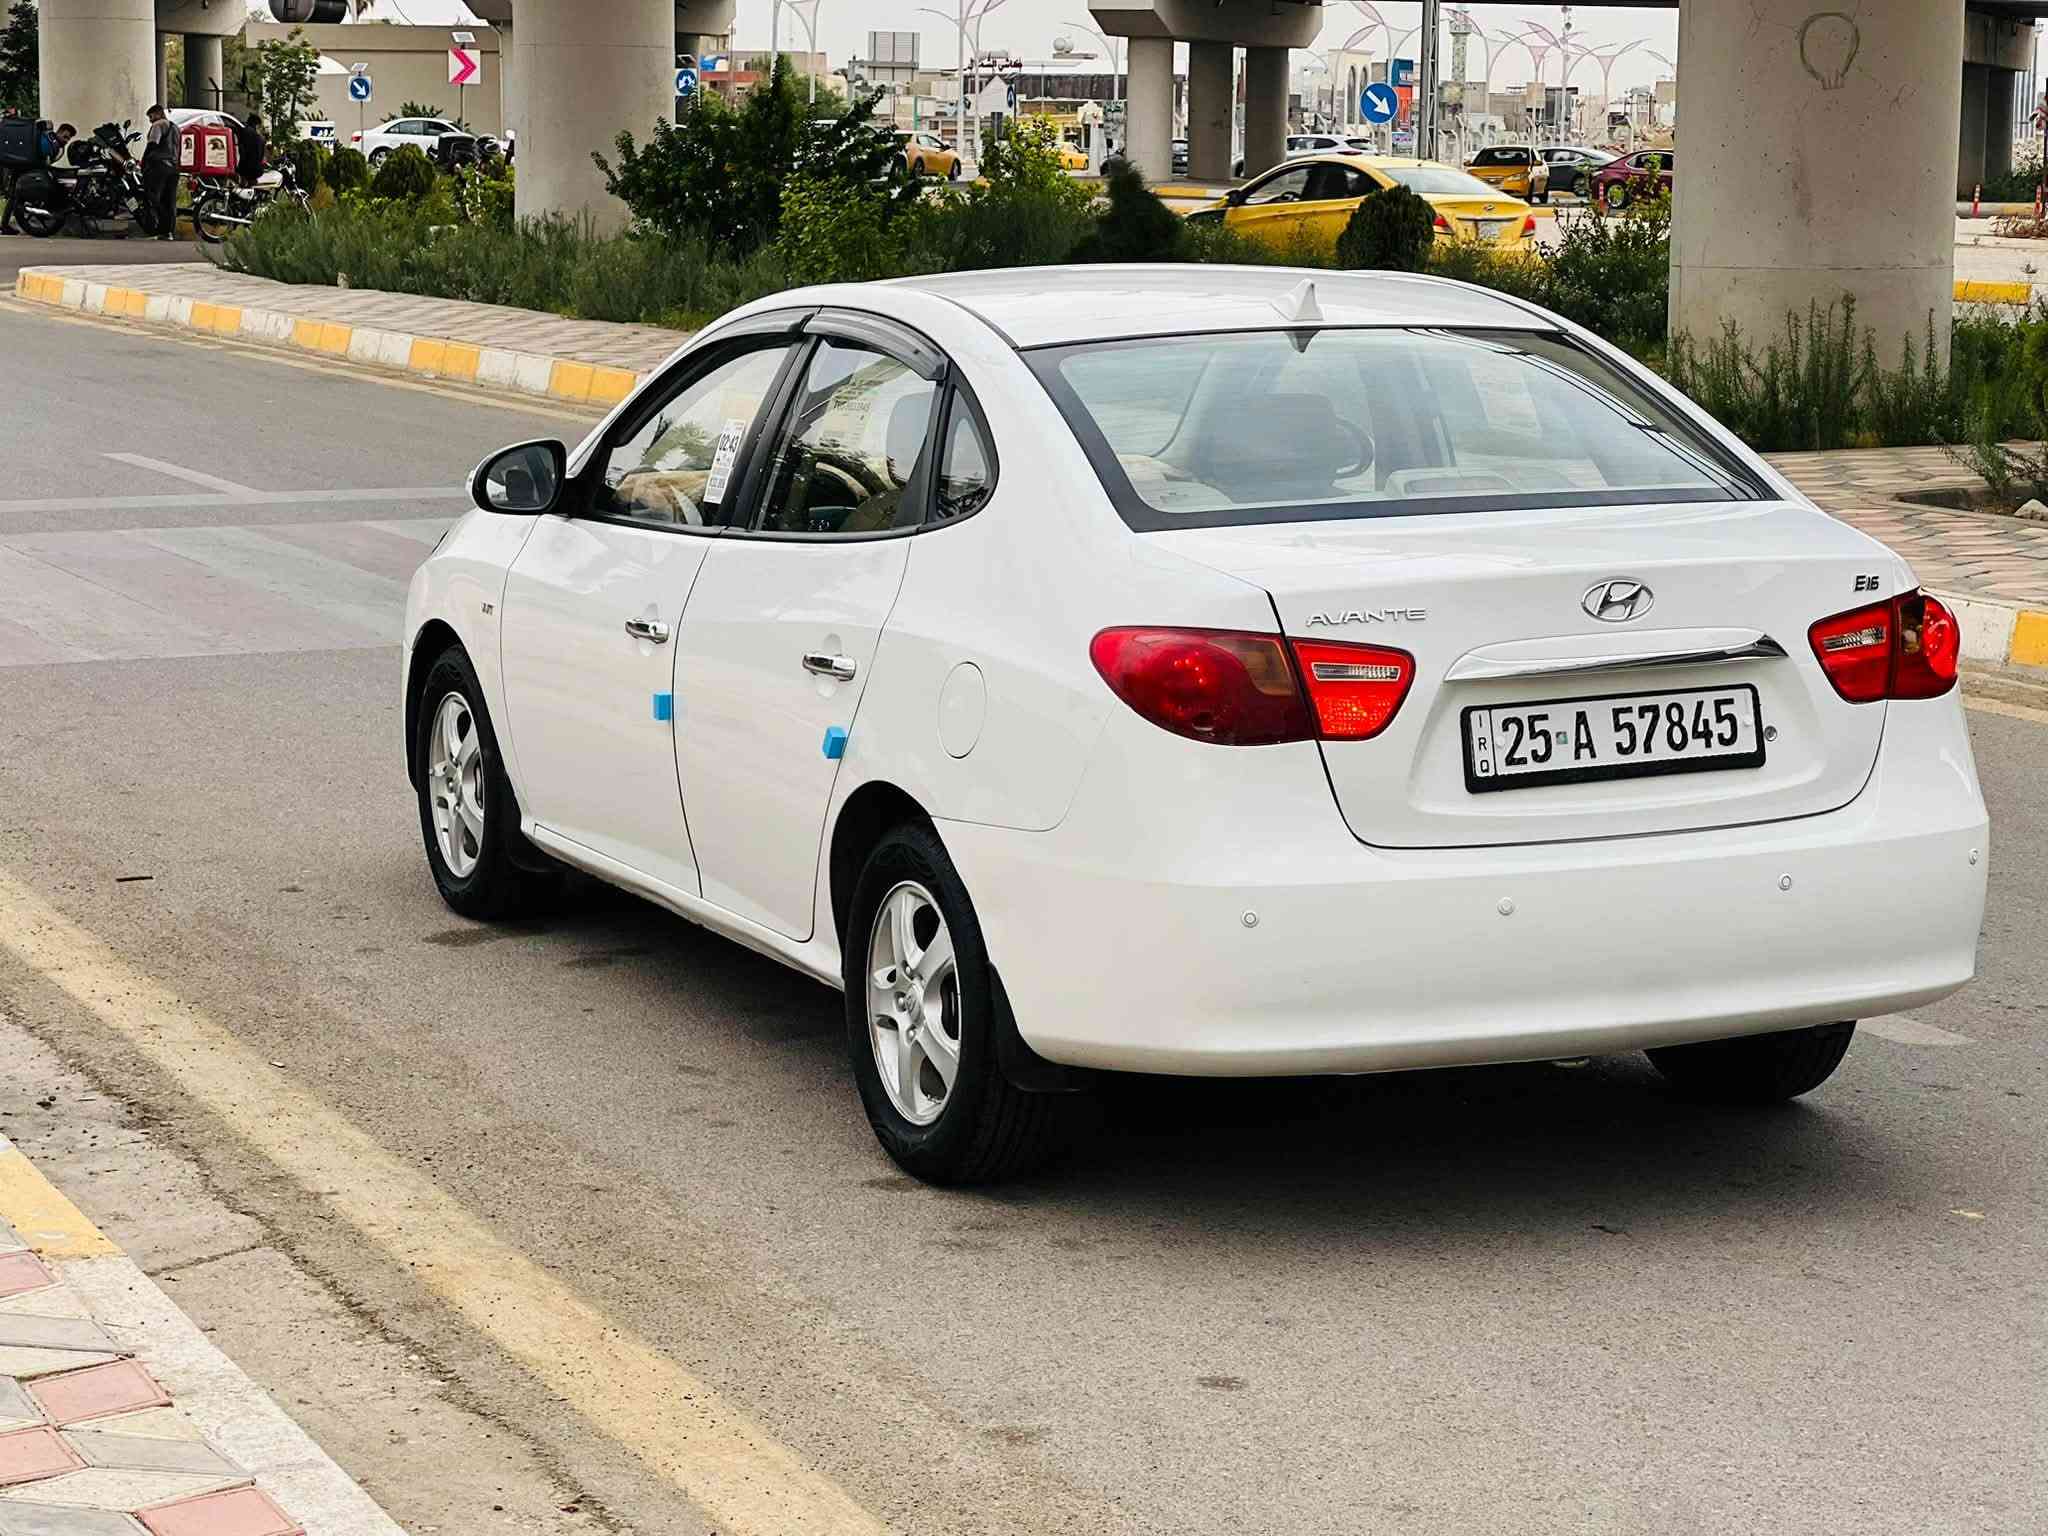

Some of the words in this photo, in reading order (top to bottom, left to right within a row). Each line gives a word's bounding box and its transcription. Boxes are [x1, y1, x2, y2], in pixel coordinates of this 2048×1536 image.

[1854, 575, 1880, 592] E16
[1305, 607, 1428, 628] AVANTE
[1501, 713, 1553, 767] 25
[1573, 710, 1597, 761] A
[1611, 698, 1738, 756] 57845
